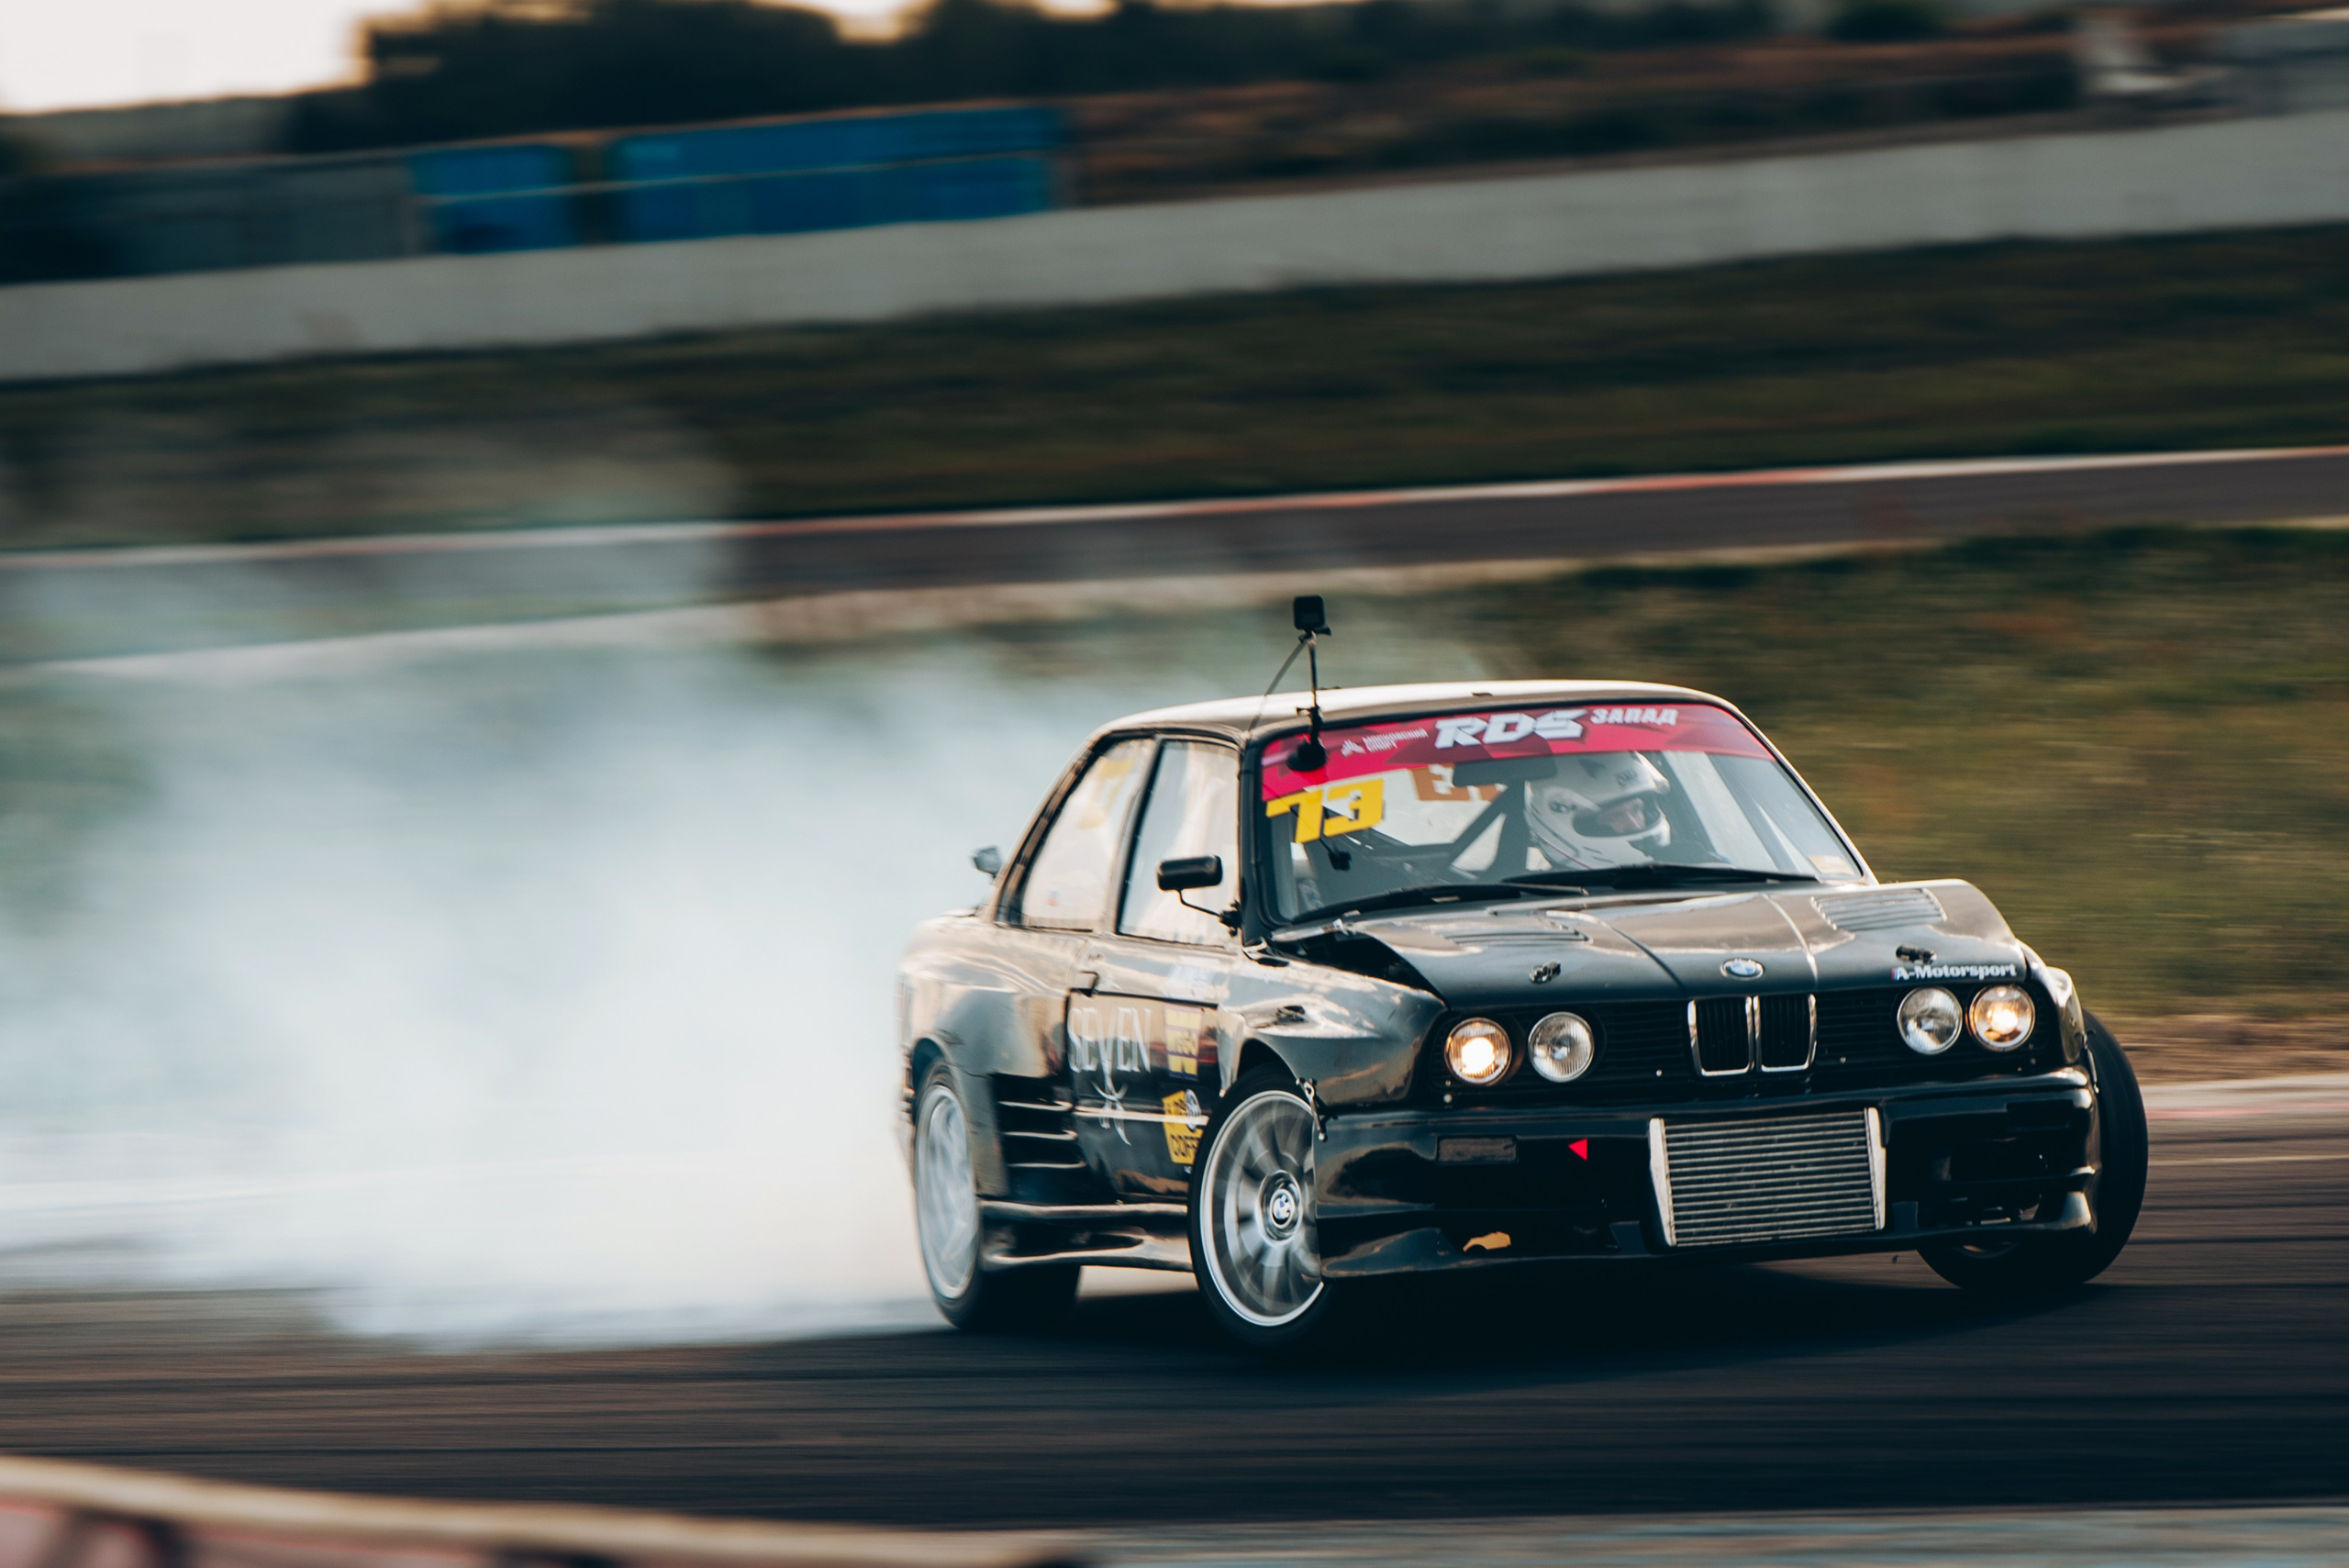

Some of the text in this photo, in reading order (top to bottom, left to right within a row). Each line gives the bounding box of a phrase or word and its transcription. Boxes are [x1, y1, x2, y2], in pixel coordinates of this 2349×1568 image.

[1434, 709, 1588, 749] RDS
[1590, 708, 1678, 726] ЗАПАД
[1265, 778, 1385, 843] 73
[1896, 963, 2017, 980] A-Motorsport
[1067, 1006, 1152, 1086] SEVEN
